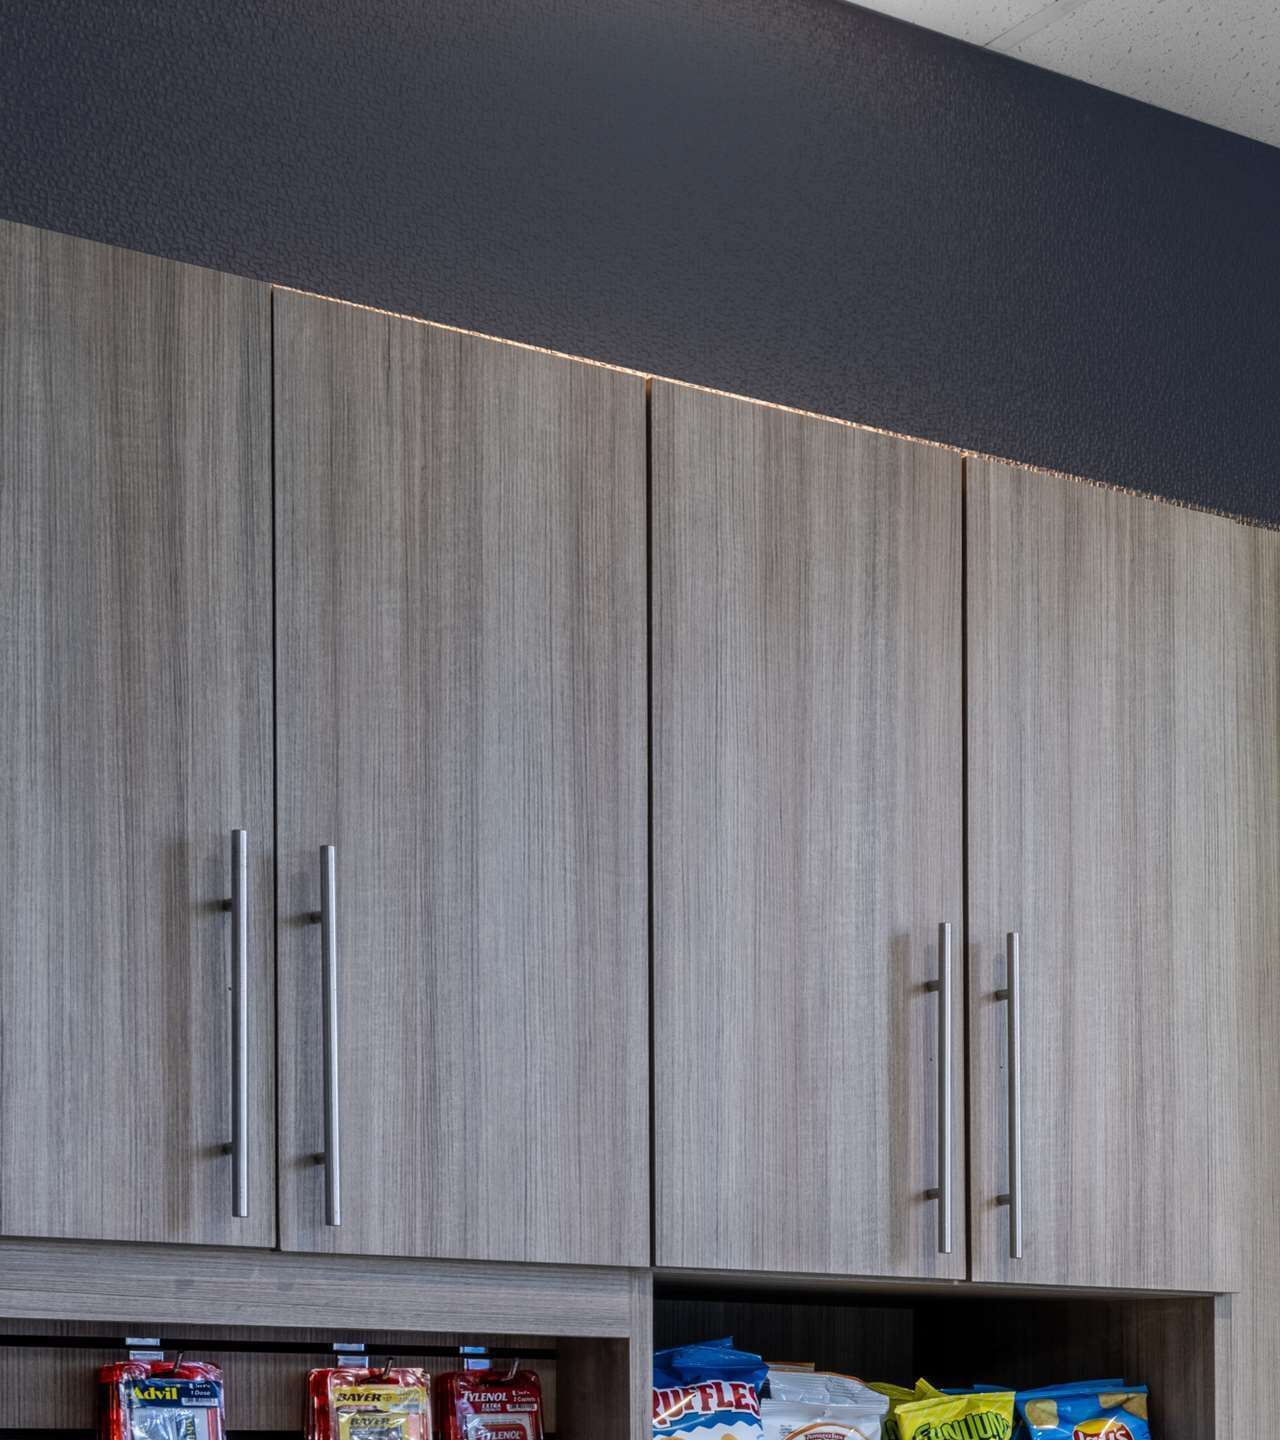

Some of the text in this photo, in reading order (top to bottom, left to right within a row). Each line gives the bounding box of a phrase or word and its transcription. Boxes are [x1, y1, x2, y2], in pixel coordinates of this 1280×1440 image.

[132, 1387, 178, 1400] Advil
[337, 1393, 382, 1402] BAYER
[461, 1391, 508, 1402] TYLENOL
[653, 1381, 761, 1425] RUFFLES
